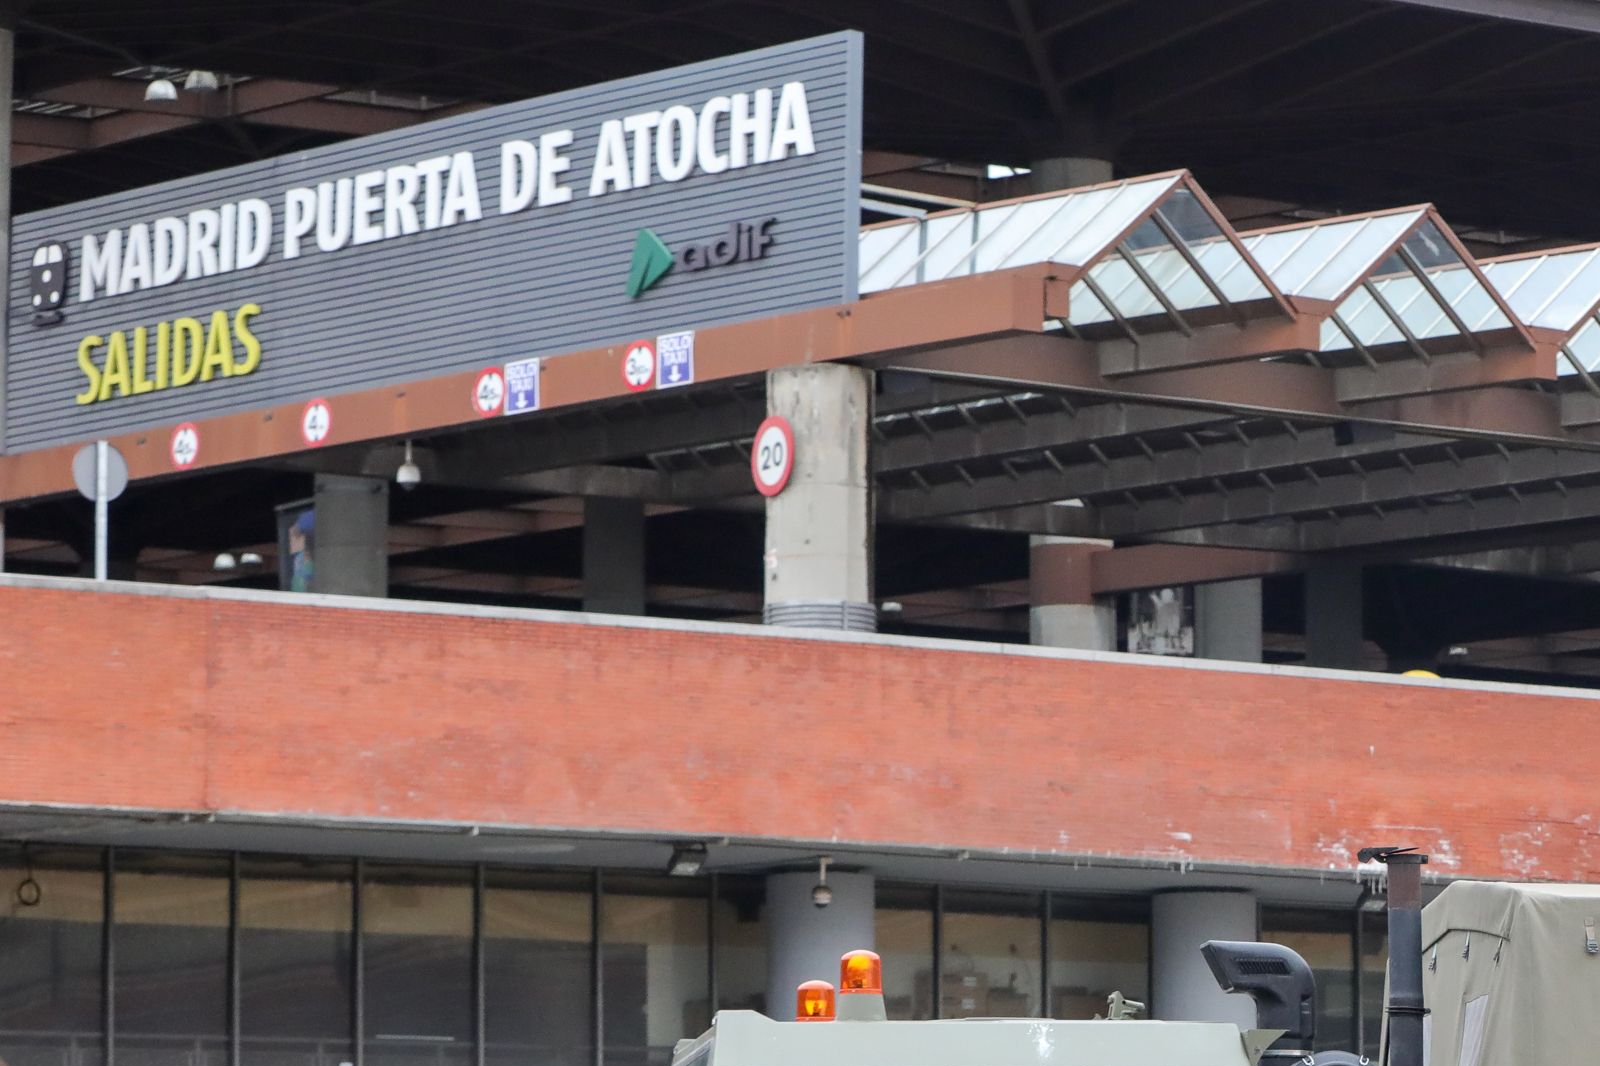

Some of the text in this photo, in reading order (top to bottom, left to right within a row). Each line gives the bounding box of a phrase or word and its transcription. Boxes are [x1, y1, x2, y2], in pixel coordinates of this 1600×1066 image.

[79, 81, 816, 302] MADRID PUERTA DE ATOCHA
[673, 216, 777, 272] adif
[76, 303, 262, 405] SALIDAS
[659, 335, 691, 353] SOLO
[663, 350, 688, 366] TAXI
[507, 363, 538, 381] SOLO
[511, 377, 534, 393] TAXI
[761, 441, 784, 471] 20
